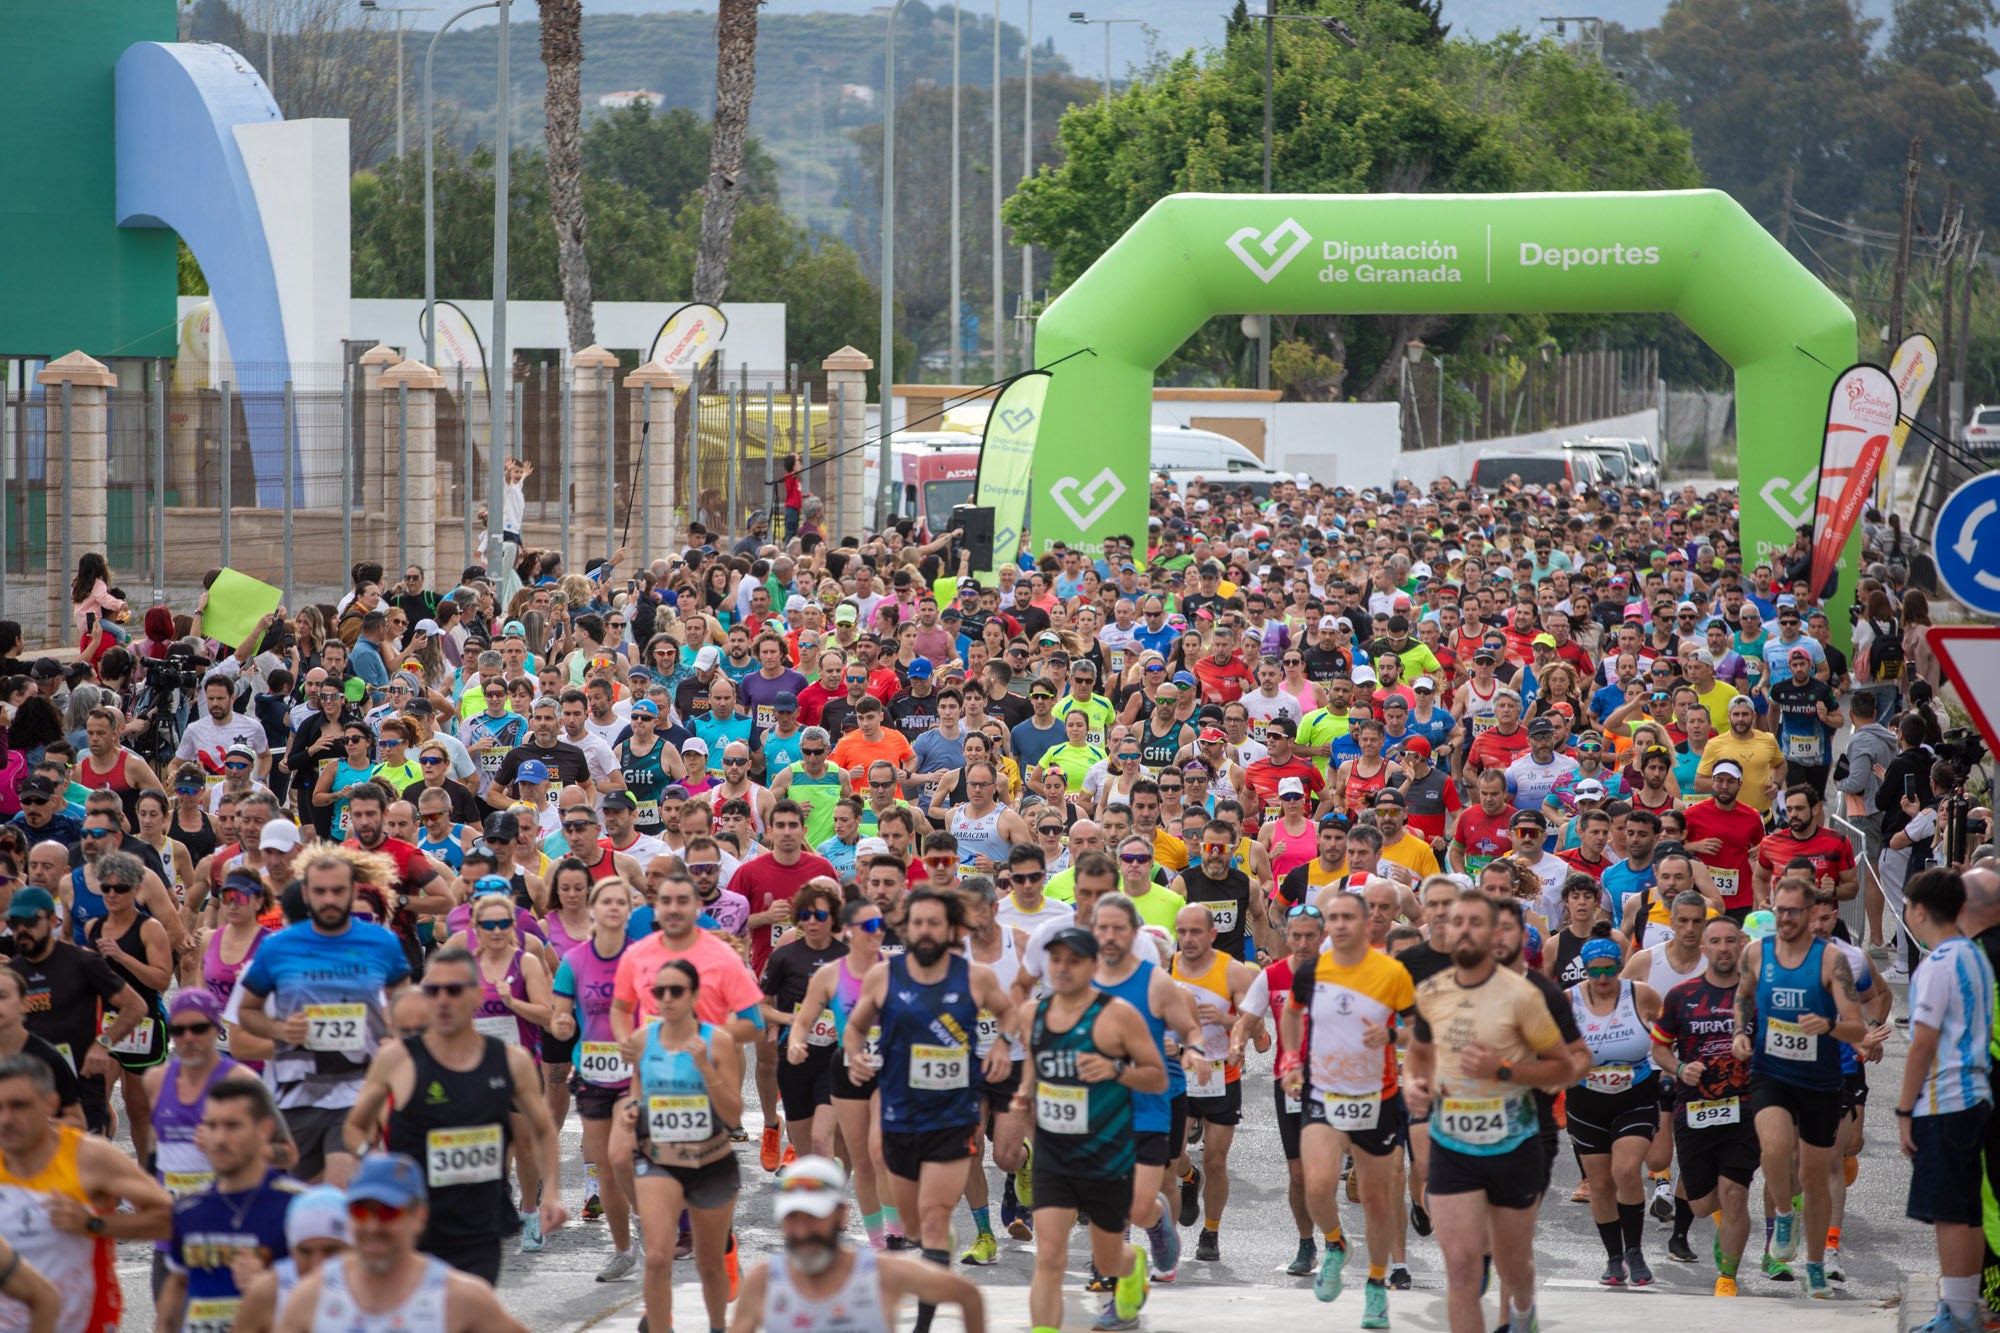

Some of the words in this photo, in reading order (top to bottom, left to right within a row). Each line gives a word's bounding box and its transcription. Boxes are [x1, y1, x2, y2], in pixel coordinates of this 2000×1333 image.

[1323, 240, 1457, 264] Diputación
[1519, 242, 1660, 271] Deportes
[1319, 264, 1349, 283] de
[1355, 264, 1462, 283] Granada
[1898, 351, 1923, 396] uzcampo
[1863, 393, 1891, 409] Sabor
[983, 483, 1025, 496] Deportes
[1841, 446, 1881, 522] saborgranada.es
[758, 712, 778, 723] 313
[1086, 733, 1101, 743] 89
[1254, 727, 1267, 736] 31
[1143, 746, 1172, 762] Giit
[1797, 743, 1811, 752] 59
[482, 755, 504, 765] 323
[623, 769, 653, 784] Giit
[925, 781, 938, 791] 32
[638, 809, 654, 819] 44
[953, 831, 989, 840] MARACENA
[1213, 911, 1232, 924] 43
[31, 1000, 52, 1012] 025
[314, 1020, 357, 1039] 732
[979, 1021, 998, 1035] 95
[1690, 1018, 1754, 1036] PIRATS
[128, 1028, 148, 1045] 11
[1772, 1031, 1809, 1051] 338
[582, 1055, 628, 1072] 4001
[920, 1062, 961, 1079] 139
[1586, 1071, 1632, 1088] 2124
[1042, 1100, 1077, 1121] 339
[1333, 1102, 1373, 1120] 492
[1695, 1106, 1732, 1122] 892
[651, 1110, 709, 1132] 4032
[1445, 1113, 1504, 1133] 1024
[432, 1144, 498, 1172] 3008
